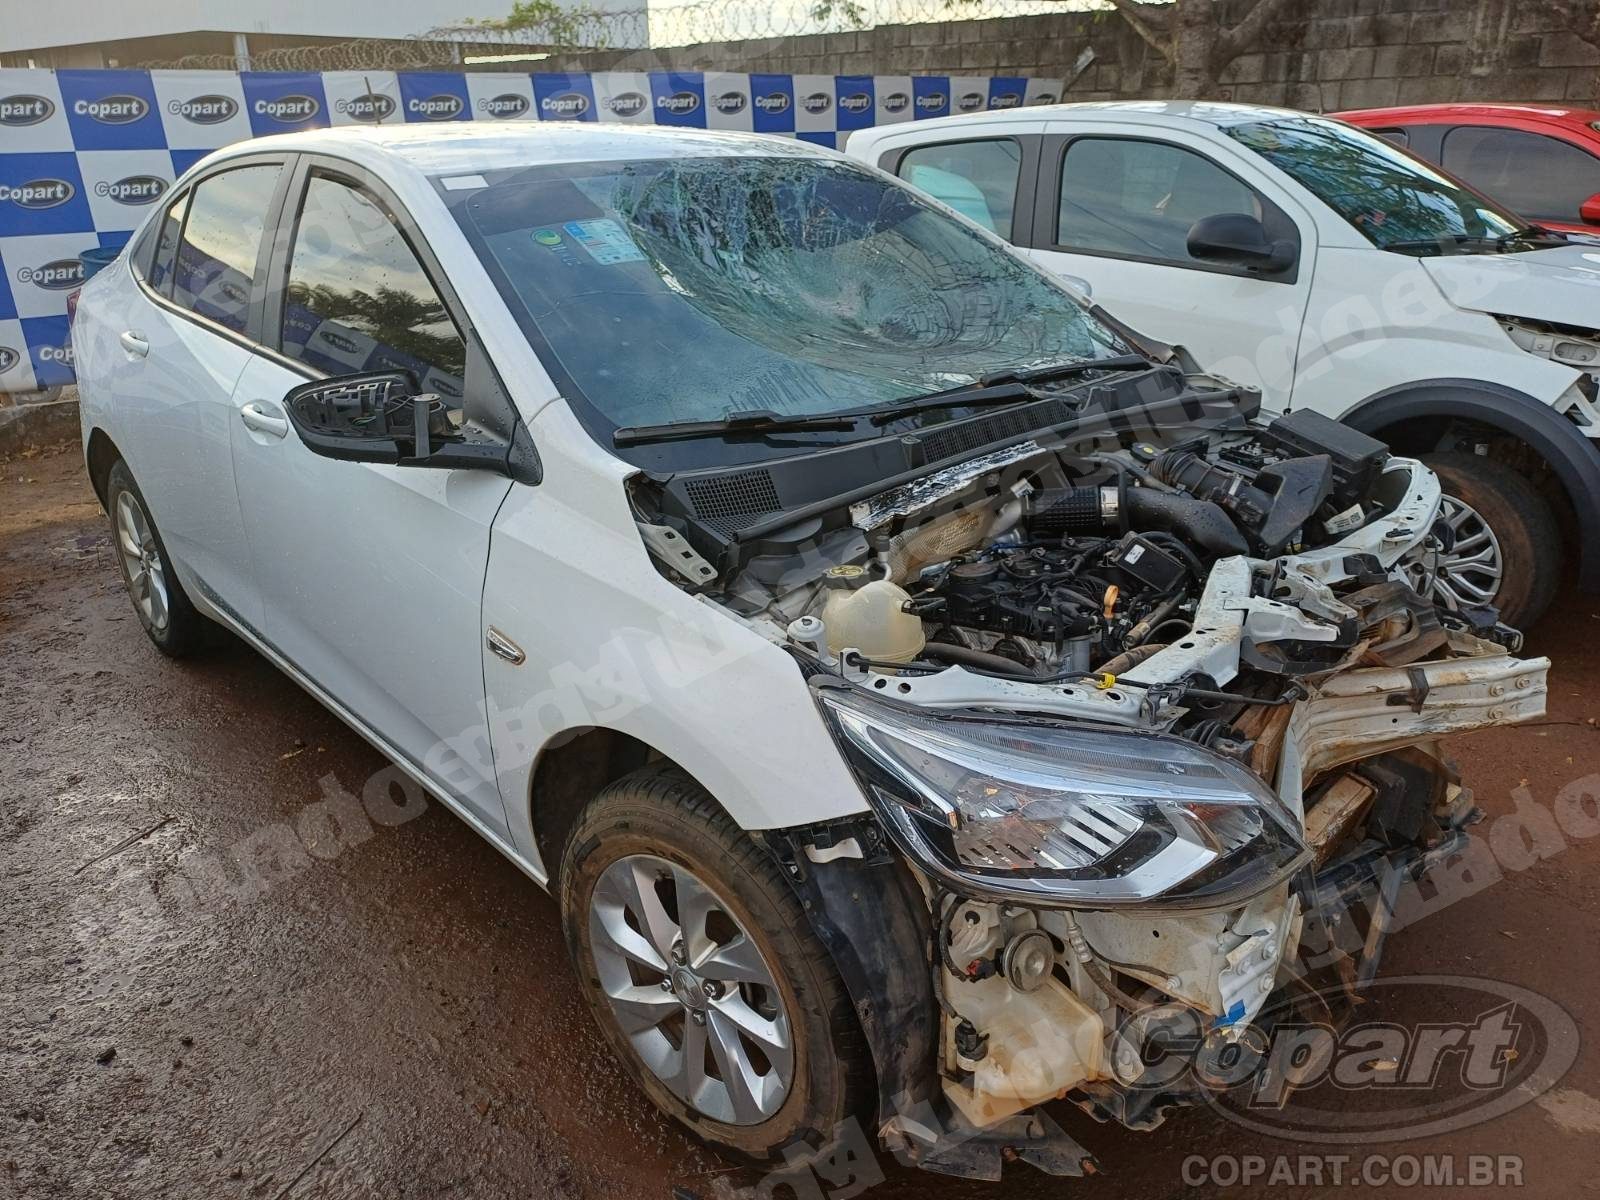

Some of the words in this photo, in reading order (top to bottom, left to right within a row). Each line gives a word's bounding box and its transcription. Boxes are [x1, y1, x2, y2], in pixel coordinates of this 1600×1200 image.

[0, 101, 43, 120] part
[74, 100, 139, 118] Copart
[167, 99, 228, 116] Copart
[254, 99, 311, 116] Copart
[335, 98, 387, 115] Copart
[409, 98, 458, 114] Copart
[477, 97, 522, 113] Copart
[541, 97, 583, 111] Copart
[602, 95, 642, 110] Copart
[656, 95, 695, 110] Copart
[711, 95, 742, 110] Copart
[754, 96, 787, 110] Copart
[0, 184, 65, 203] Copart
[95, 181, 158, 199] Copart
[17, 266, 86, 284] Copart
[39, 347, 75, 361] Cop
